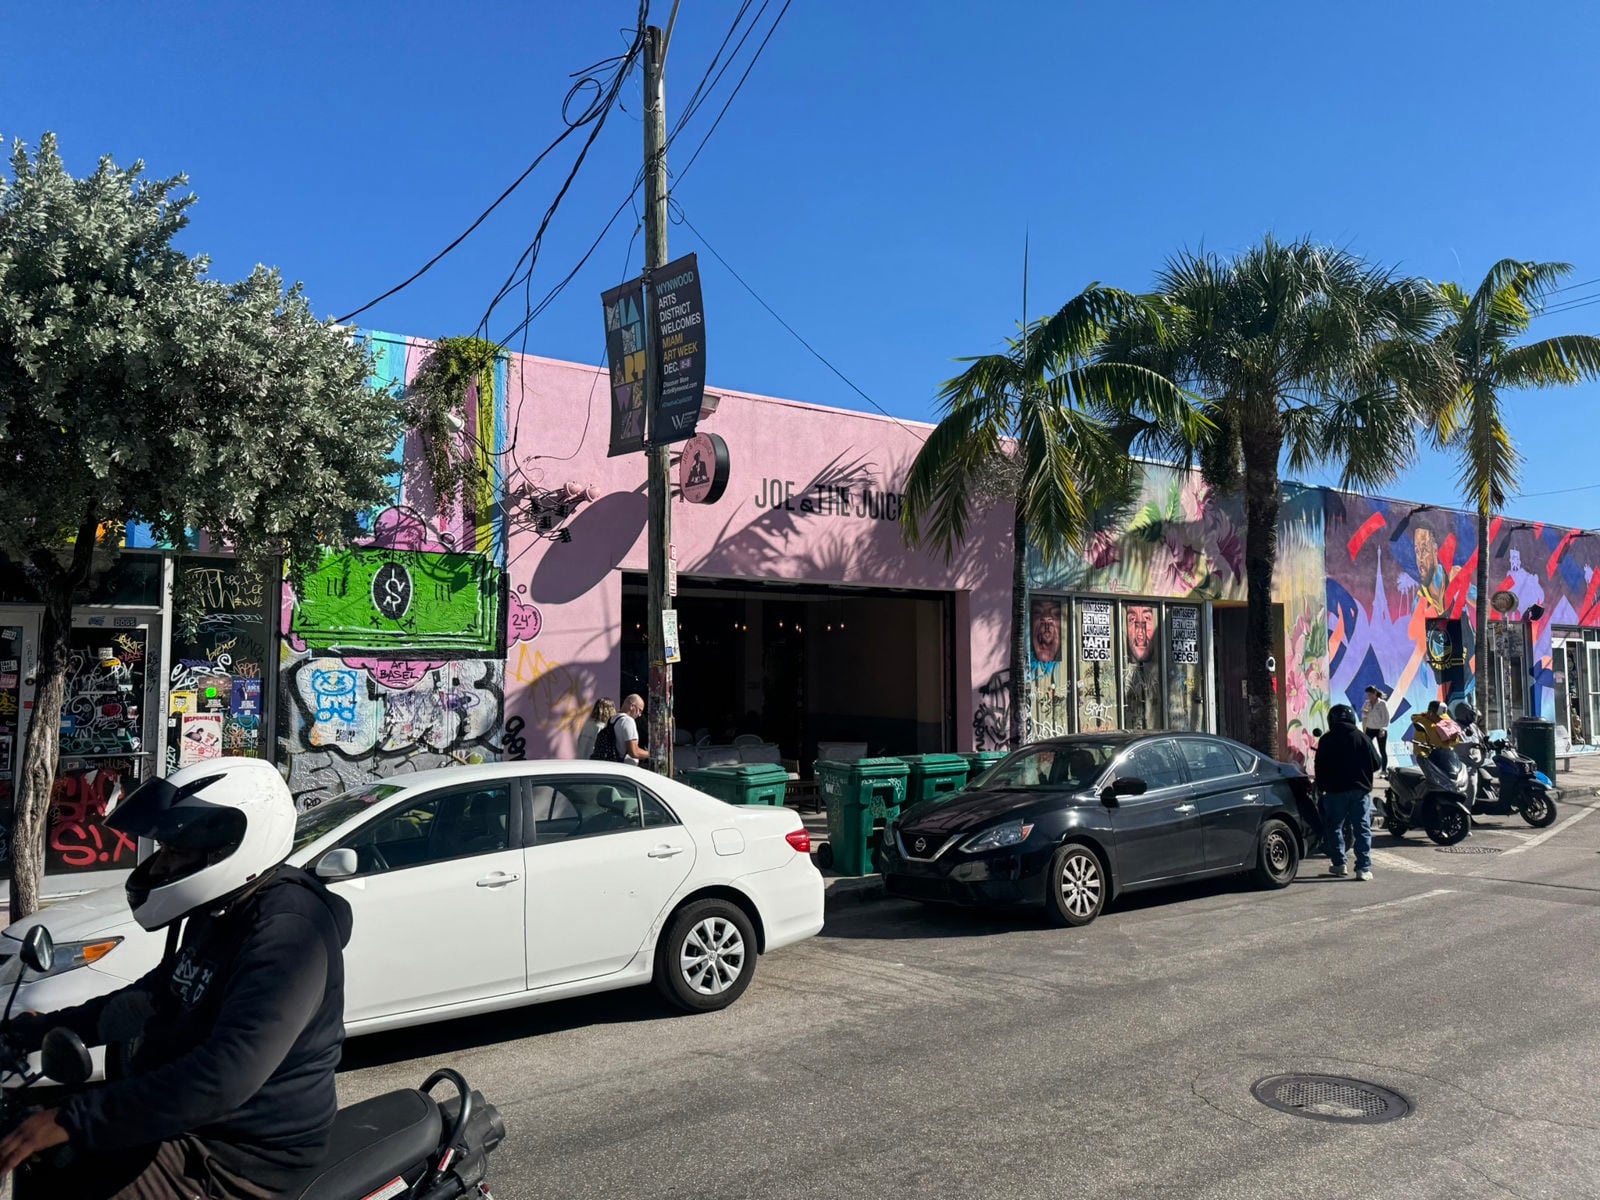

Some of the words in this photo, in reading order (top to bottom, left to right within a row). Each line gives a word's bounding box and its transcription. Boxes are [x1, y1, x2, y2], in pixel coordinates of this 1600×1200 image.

[656, 271, 694, 295] WYNWOOD
[659, 293, 677, 309] ARTS
[660, 301, 691, 322] DISTRICT
[661, 312, 702, 335] WELCOMES
[662, 333, 684, 349] MIAMI
[663, 349, 677, 363] ART
[677, 341, 698, 358] WEEK
[663, 361, 680, 375] DEC.
[754, 478, 795, 511] JOE
[800, 499, 814, 512] &
[815, 484, 850, 516] THE
[1083, 614, 1110, 624] BETWEEN
[1173, 620, 1196, 629] BETWEEN
[1083, 625, 1110, 636] LANGUAGE
[1173, 630, 1196, 640] LANGUAGE
[379, 669, 419, 680] BASEL
